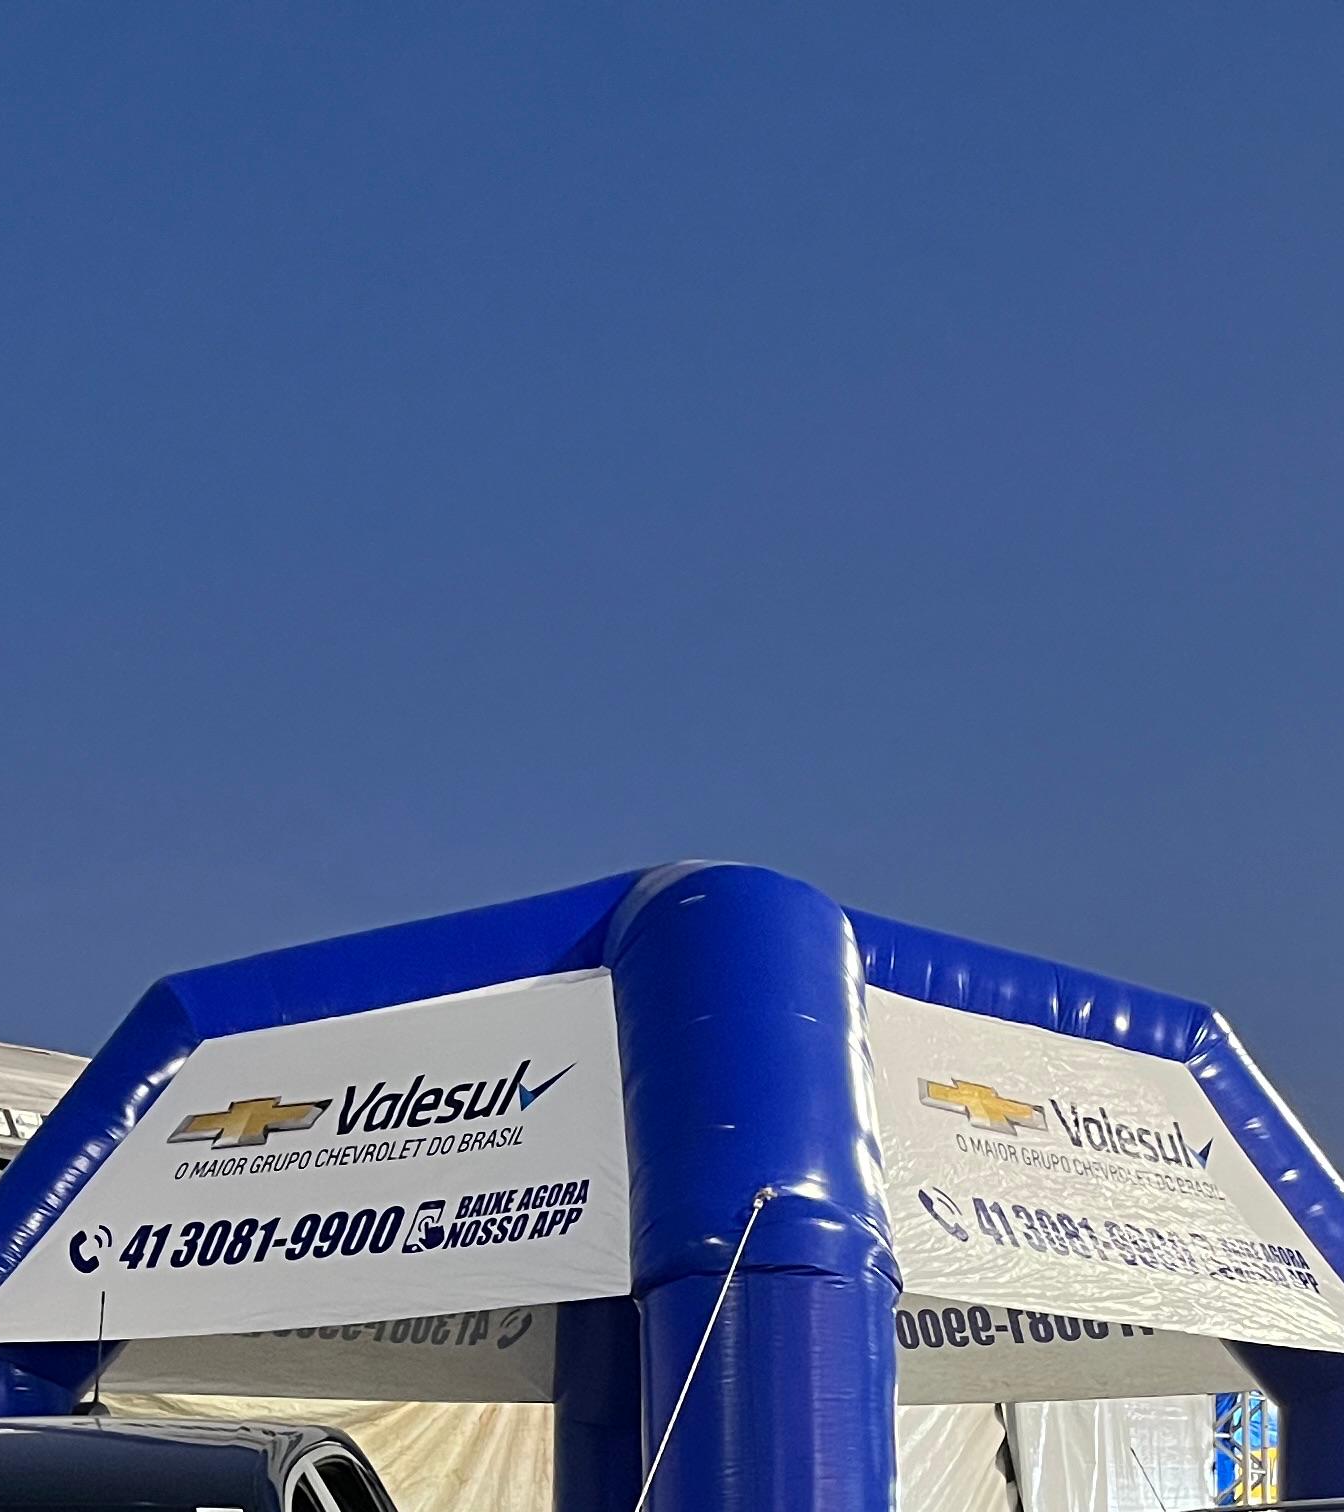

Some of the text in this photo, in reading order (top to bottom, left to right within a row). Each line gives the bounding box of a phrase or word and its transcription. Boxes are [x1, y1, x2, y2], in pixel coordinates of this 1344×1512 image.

[336, 1060, 533, 1137] Valesul
[174, 1125, 525, 1180] O MAIOR GRUPO CHEVROLET DO BRASIL
[955, 1133, 968, 1153] O
[968, 1136, 1019, 1164] MAIOR
[1021, 1147, 1072, 1173] GRUPO
[1049, 1099, 1194, 1168] Valesul
[455, 1179, 591, 1220] BAIXE AGORA
[972, 1196, 1020, 1248] 41
[118, 1205, 406, 1270] 41 3081-9900
[442, 1206, 584, 1250] NOSSO APP
